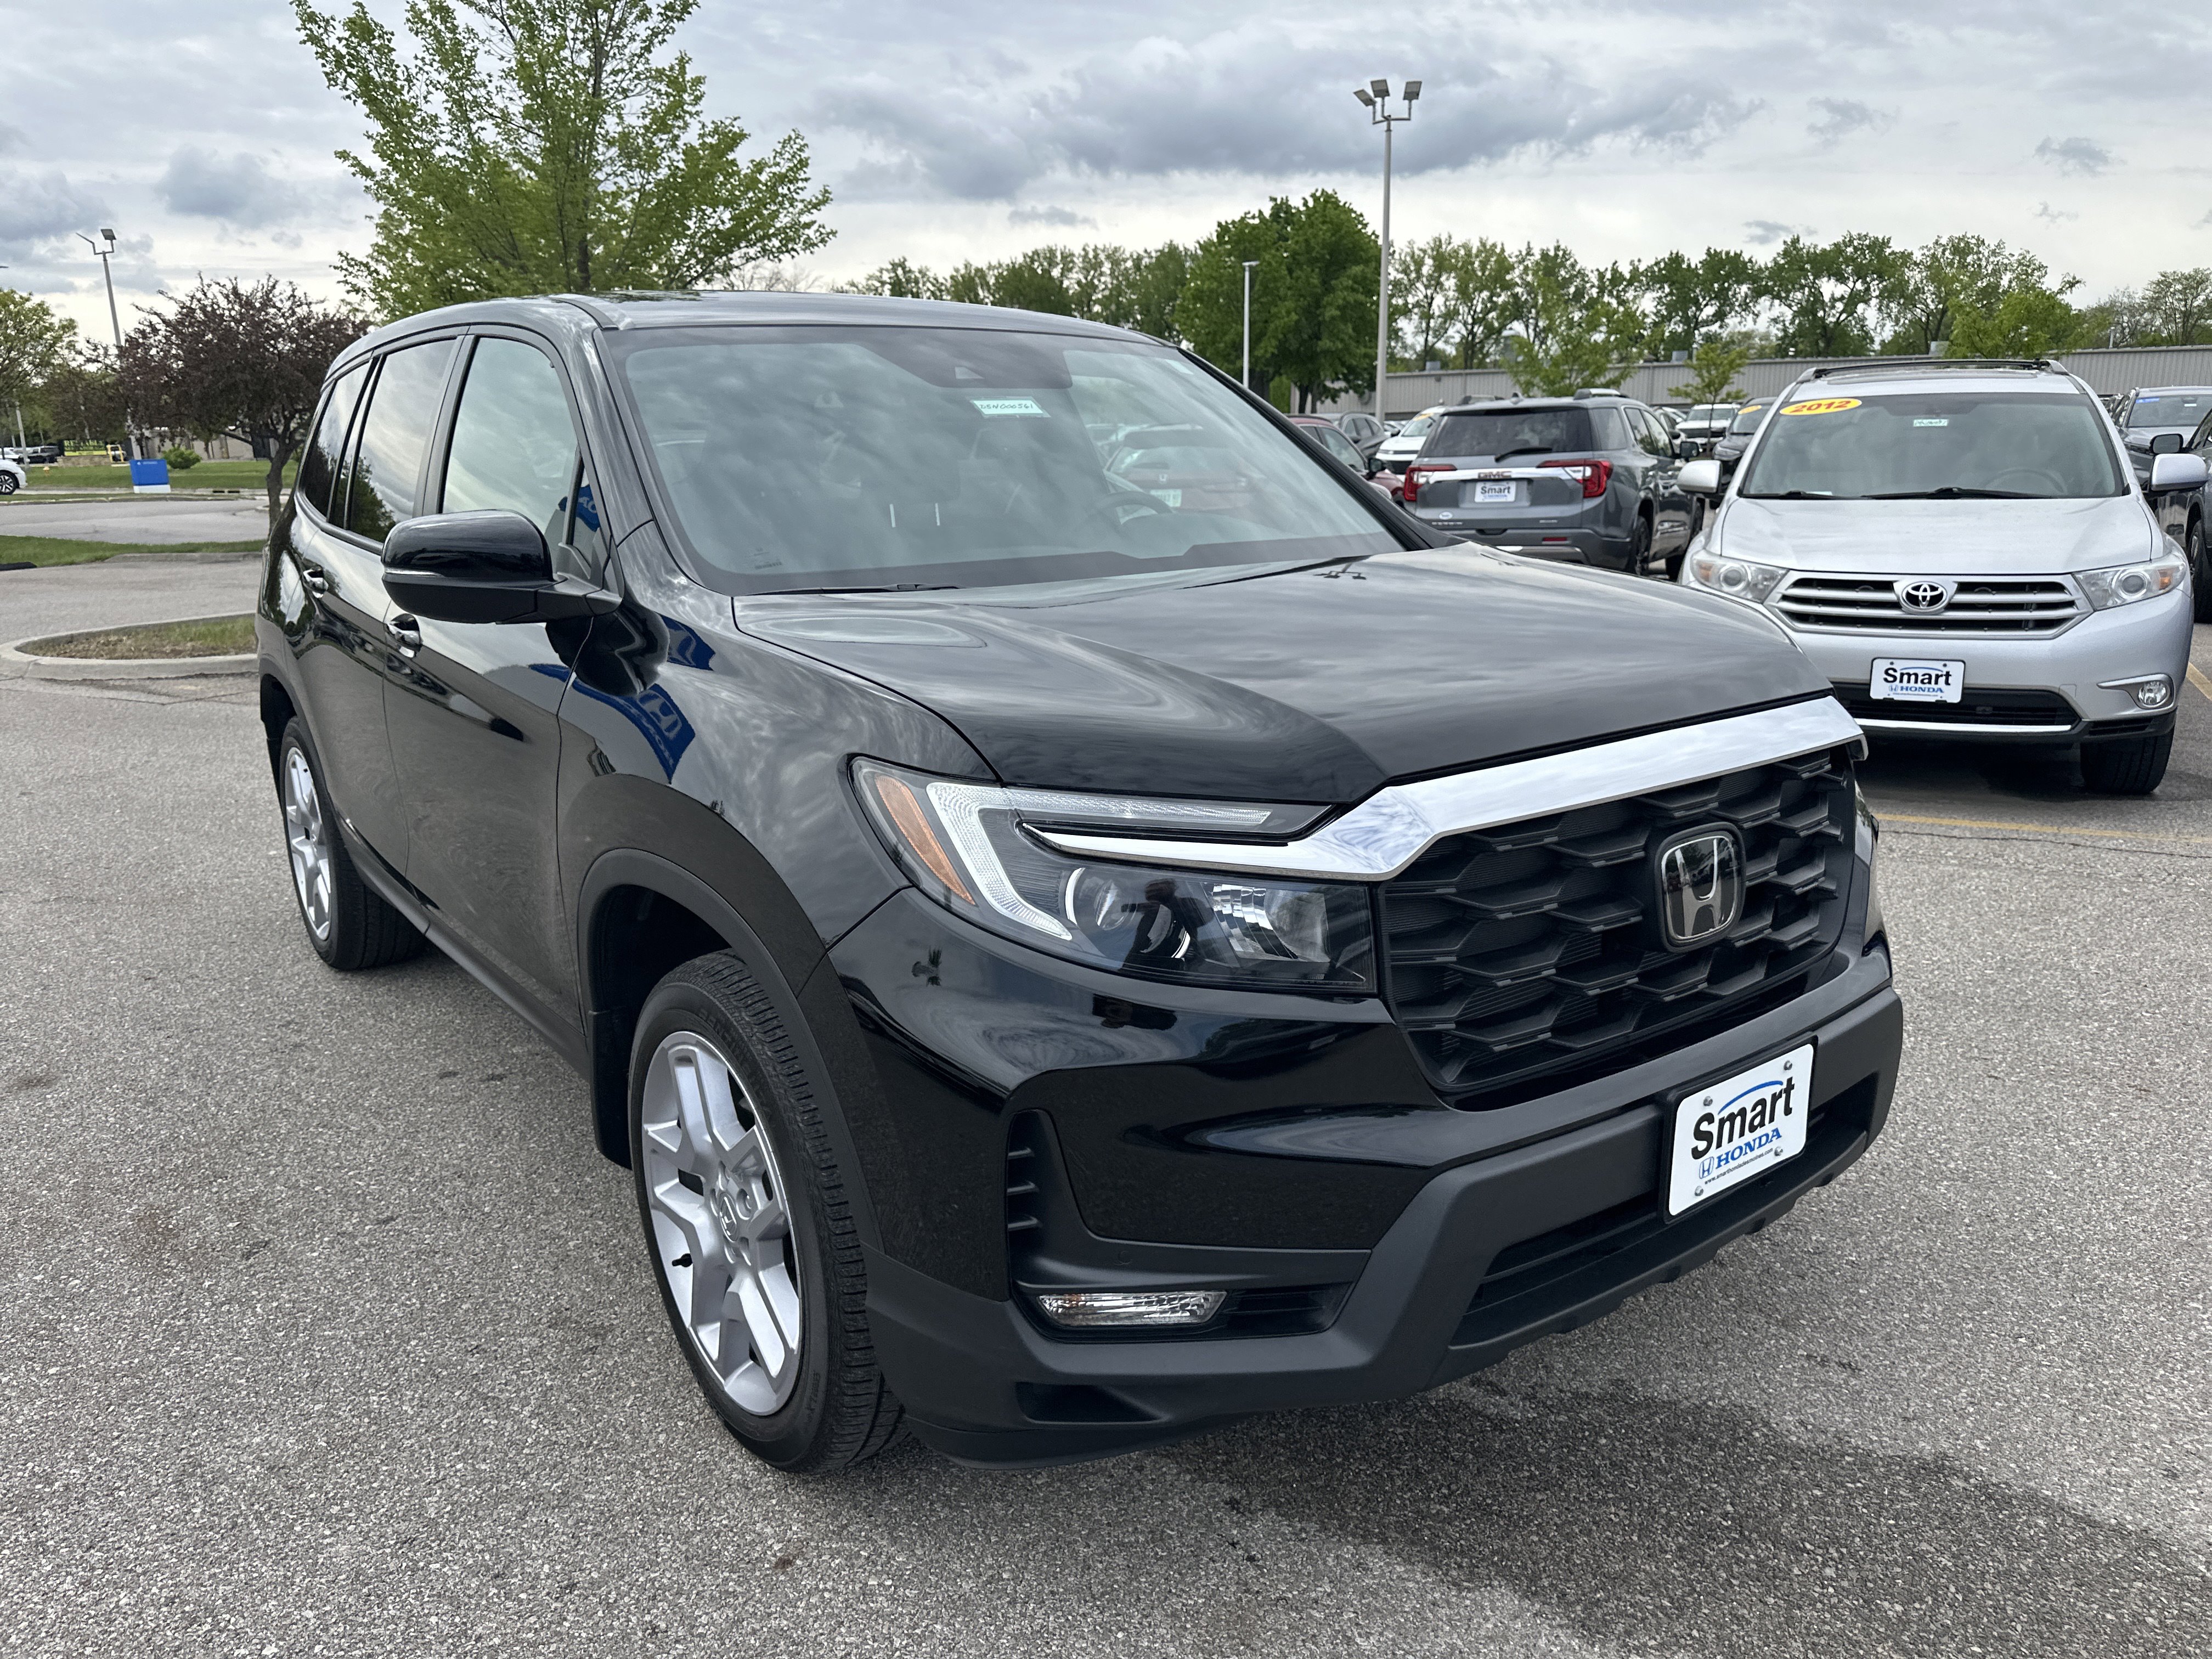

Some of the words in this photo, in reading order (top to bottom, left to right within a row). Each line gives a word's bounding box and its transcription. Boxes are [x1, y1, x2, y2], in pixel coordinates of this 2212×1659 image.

[1790, 400, 1852, 413] 2012
[1478, 471, 1512, 479] GMC
[1481, 486, 1511, 494] Smart
[1883, 667, 1952, 686] Smart
[1691, 1076, 1796, 1160] Smart
[1715, 1127, 1782, 1170] HONDA
